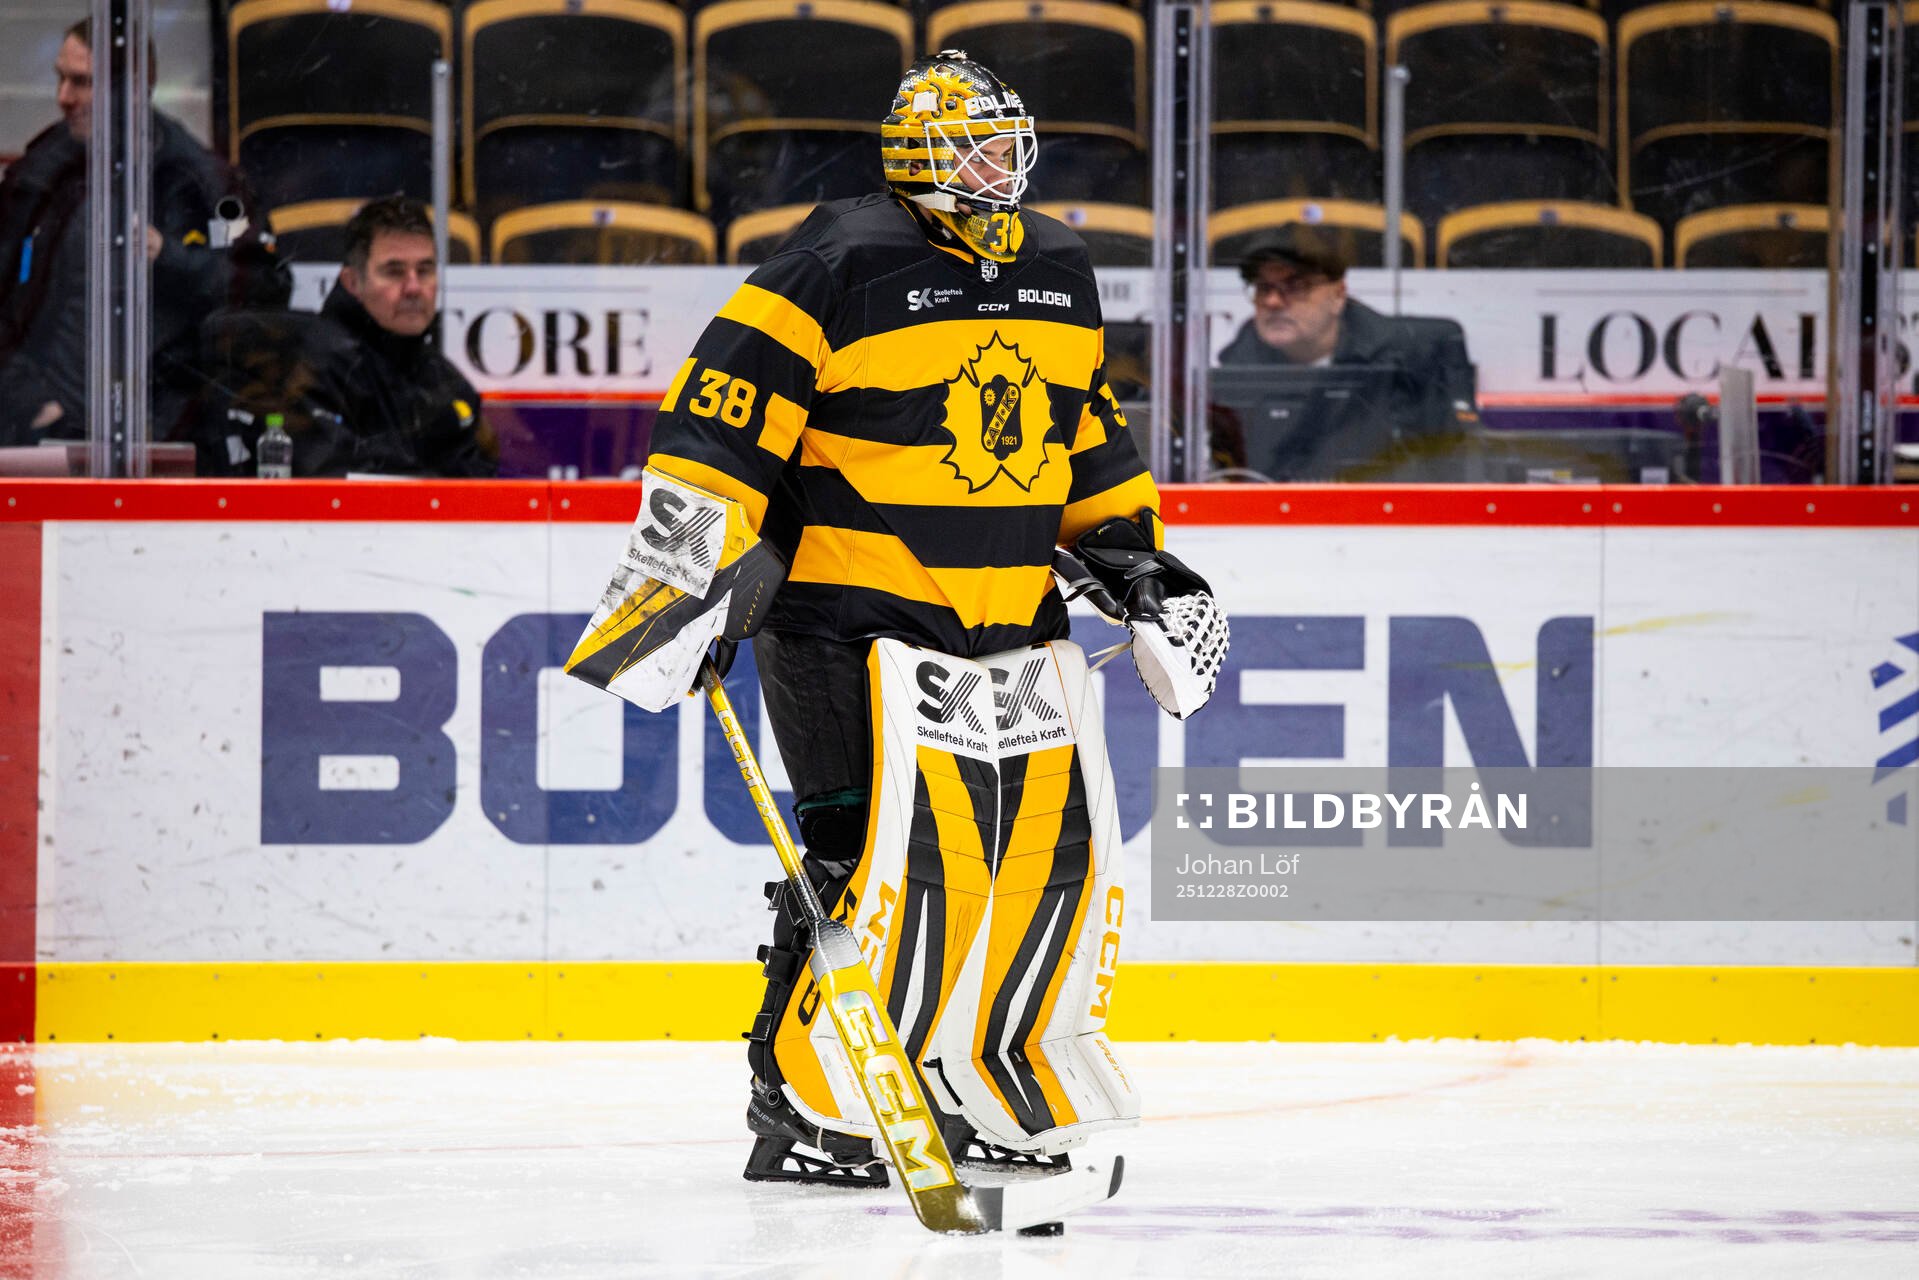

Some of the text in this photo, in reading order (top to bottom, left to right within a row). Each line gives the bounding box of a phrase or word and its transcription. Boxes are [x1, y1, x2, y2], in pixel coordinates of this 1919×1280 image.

[981, 265, 998, 279] 50
[907, 287, 935, 311] SK
[934, 287, 963, 297] Skellefteå
[1018, 288, 1072, 308] BOLIDEN
[977, 303, 1010, 312] CCM
[688, 368, 757, 429] 38
[1001, 436, 1018, 446] 1921
[718, 708, 762, 789] CCM
[917, 725, 989, 753] Skellefteå Kraft
[997, 726, 1067, 750] ellefteå Kraft
[1089, 885, 1125, 1019] CCM
[837, 989, 957, 1193] CCM
